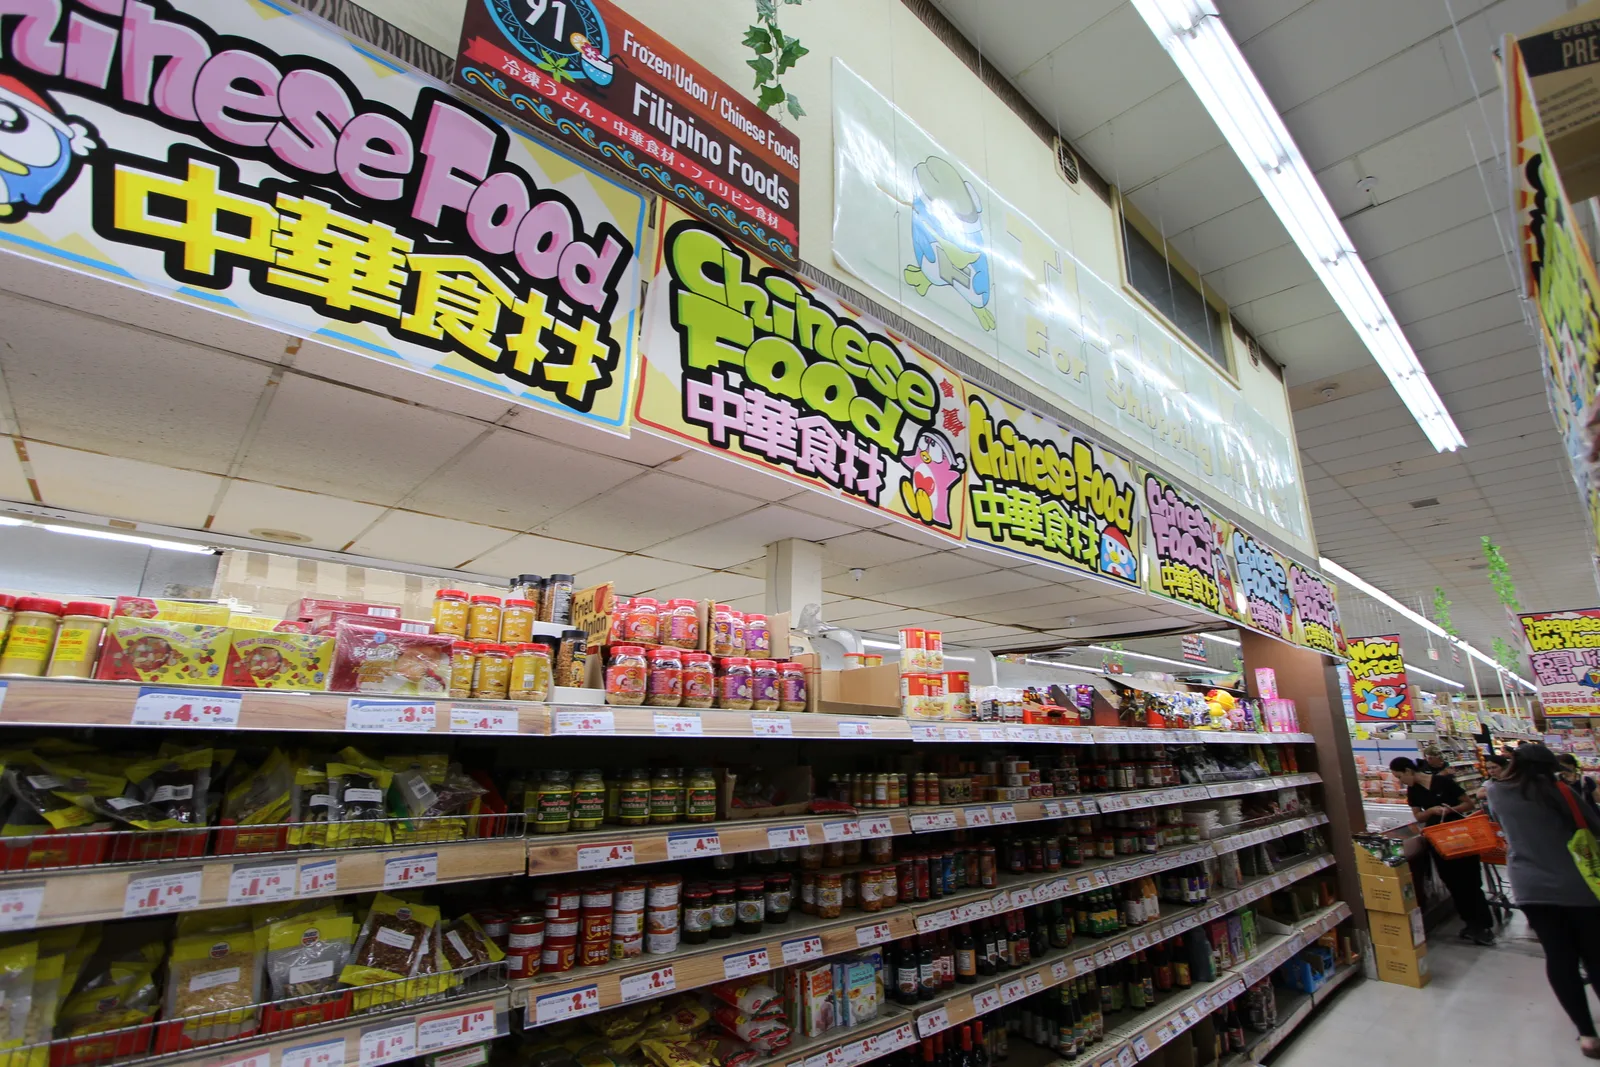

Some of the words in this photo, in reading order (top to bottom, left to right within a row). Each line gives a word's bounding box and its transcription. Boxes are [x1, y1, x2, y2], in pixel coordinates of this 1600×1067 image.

[525, 0, 567, 43] 91
[622, 29, 674, 82] Frozen
[674, 66, 709, 106] Udon
[710, 91, 718, 112] /
[719, 94, 766, 145] Chinese
[766, 130, 800, 169] Foods
[632, 82, 722, 166] Filipino
[728, 144, 790, 210] Foods
[412, 99, 619, 313] Food
[114, 159, 611, 402] 中華食材
[673, 229, 936, 420] Chinese
[678, 289, 904, 456] Food
[686, 371, 885, 503] 中華食材
[970, 398, 1078, 504] Chinese
[1074, 440, 1134, 533] Food
[973, 480, 1099, 570] 中華食材
[1146, 476, 1214, 544] Chinese
[1151, 513, 1214, 578] Food
[1233, 530, 1286, 588] Chinese
[574, 594, 594, 620] Fried
[1161, 560, 1219, 613] 中華食材
[1238, 563, 1281, 609] Food
[1289, 565, 1330, 606] Chinese
[1294, 591, 1330, 627] Food
[583, 614, 607, 635] Onion
[1521, 616, 1600, 635] Japanese
[1526, 631, 1564, 652] Hot
[1537, 667, 1578, 686] 商品
